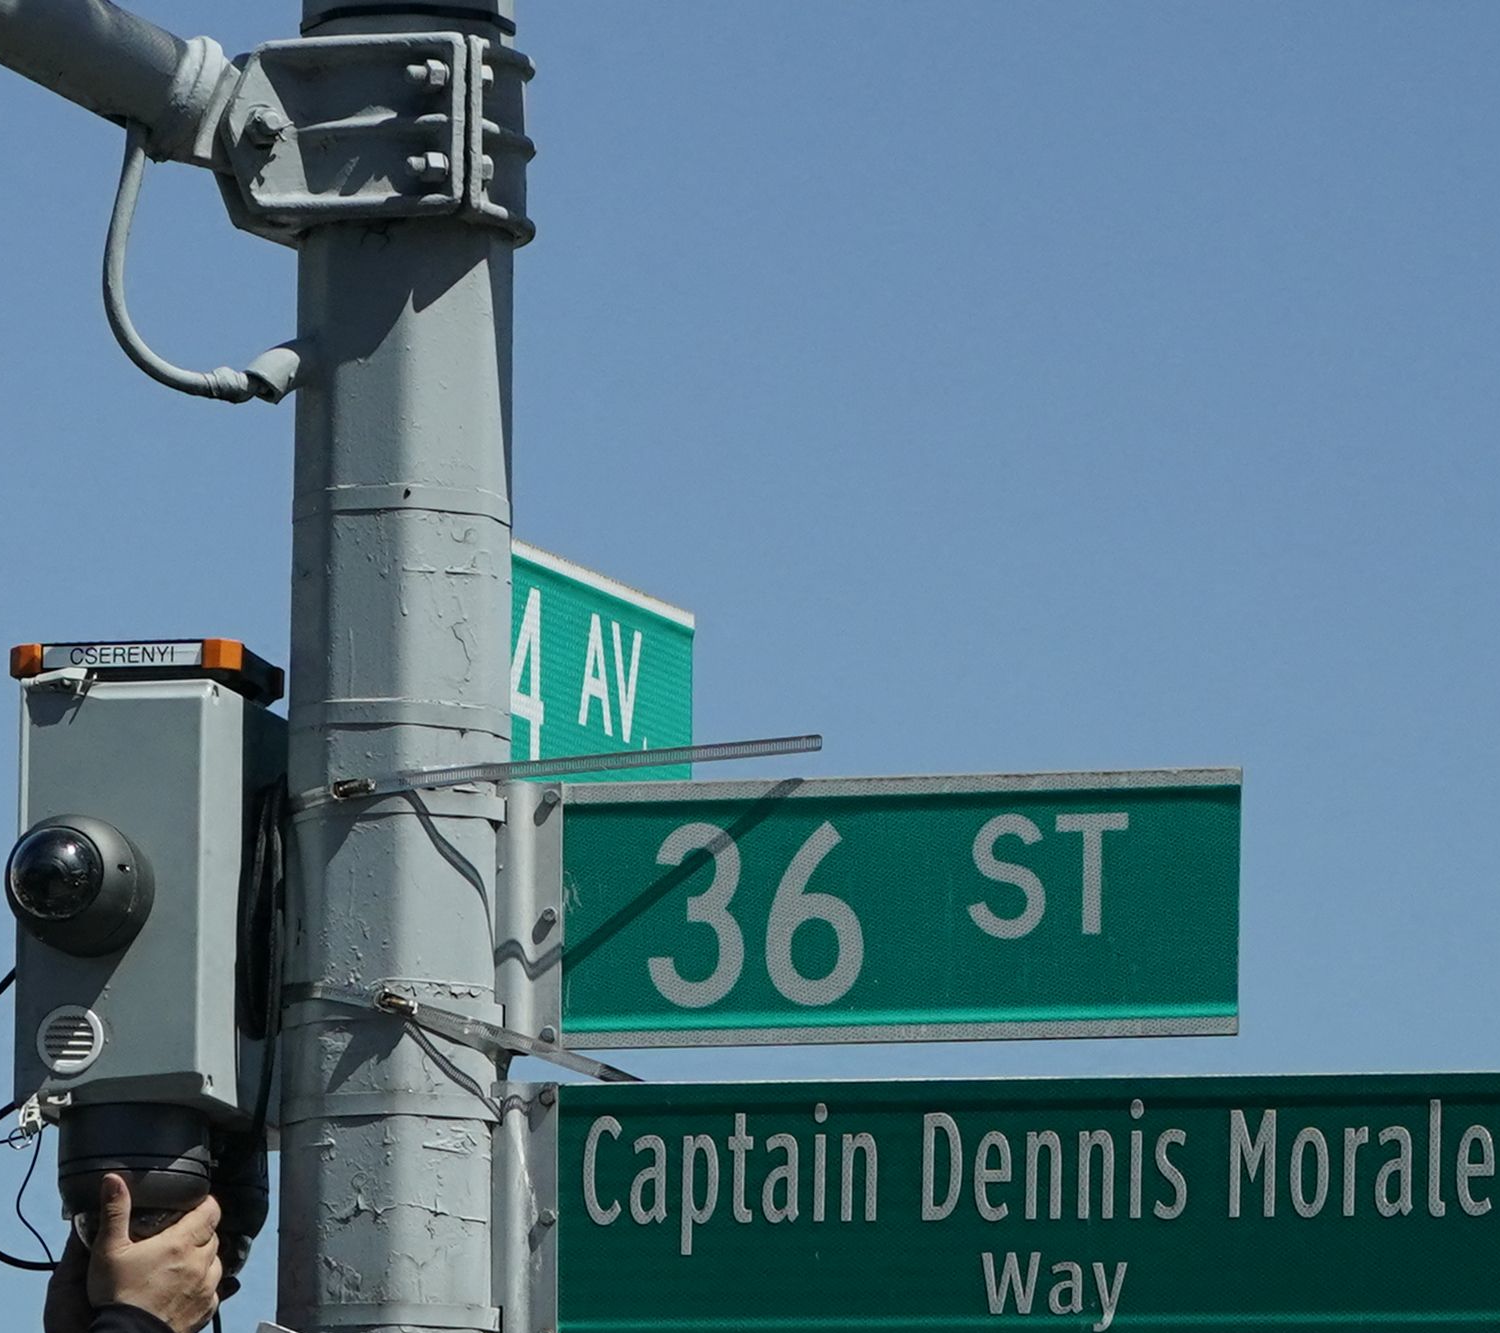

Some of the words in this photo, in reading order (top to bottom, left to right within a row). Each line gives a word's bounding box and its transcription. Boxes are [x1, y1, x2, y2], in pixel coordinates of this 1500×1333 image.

[69, 645, 176, 666] CSERENYI
[510, 587, 544, 761] 4
[578, 613, 643, 743] AV
[648, 820, 865, 1008] 36
[967, 812, 1130, 940] ST
[581, 1101, 879, 1256] Captain
[921, 1098, 1188, 1223] Dennis
[980, 1250, 1129, 1332] Way
